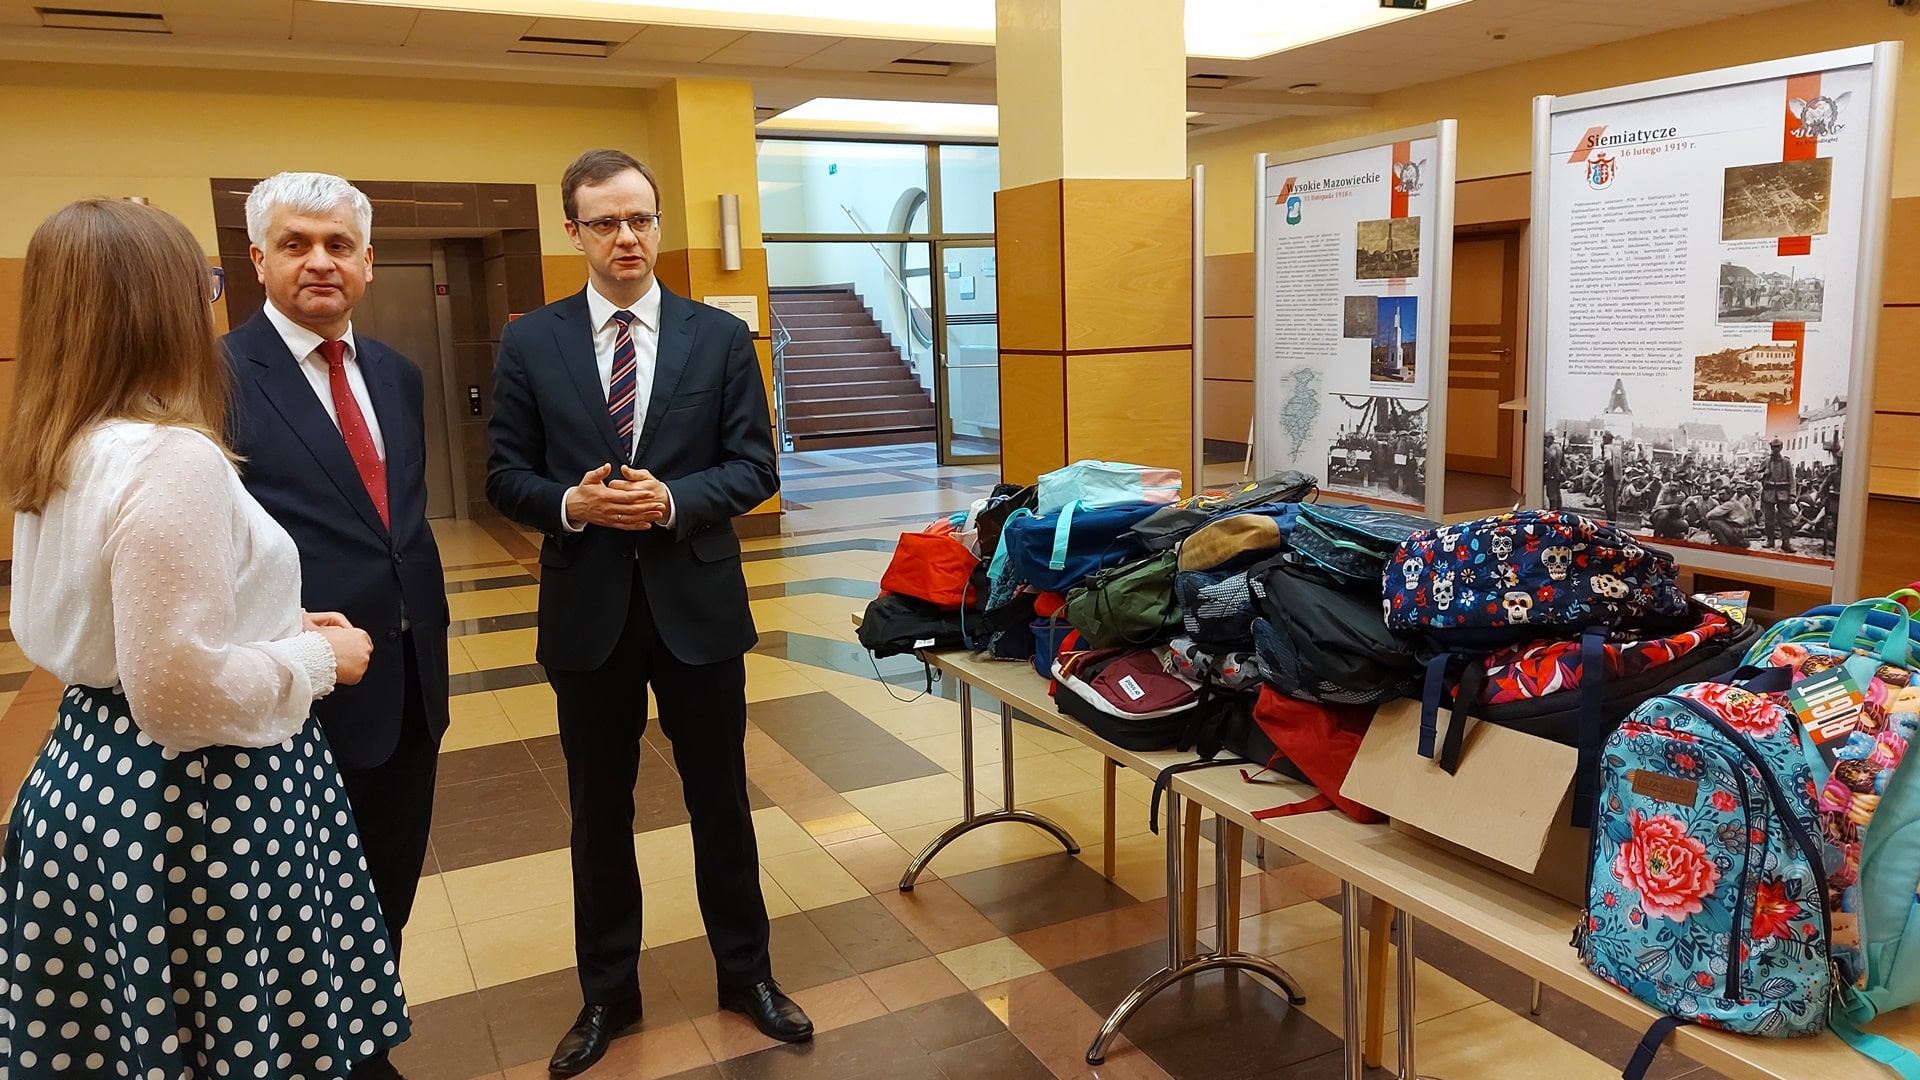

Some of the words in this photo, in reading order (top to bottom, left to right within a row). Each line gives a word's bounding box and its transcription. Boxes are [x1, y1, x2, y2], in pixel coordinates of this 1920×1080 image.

[1587, 126, 1676, 147] Siemiatycze
[1633, 146, 1661, 156] lutego
[1665, 142, 1687, 151] 1919
[1287, 181, 1321, 194] Wysokie
[1323, 173, 1380, 189] Mazowieckie
[1311, 193, 1334, 201] listopada
